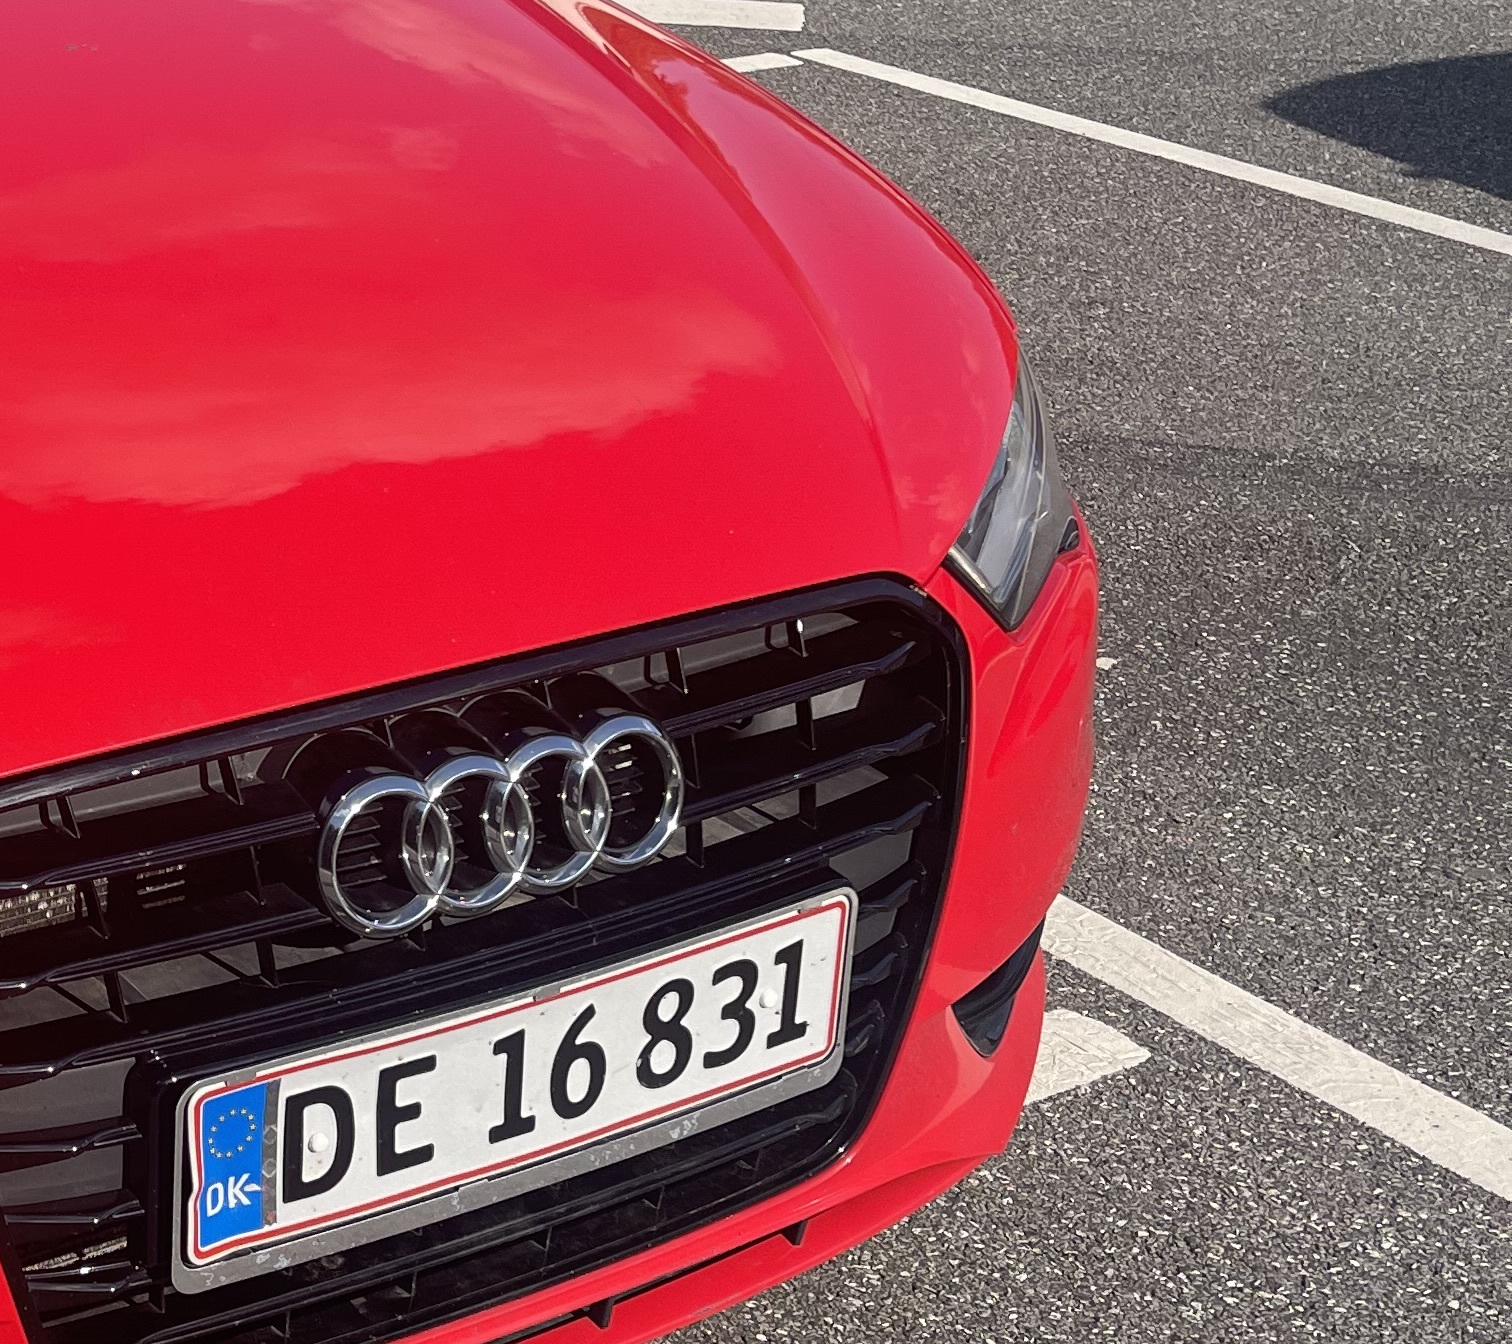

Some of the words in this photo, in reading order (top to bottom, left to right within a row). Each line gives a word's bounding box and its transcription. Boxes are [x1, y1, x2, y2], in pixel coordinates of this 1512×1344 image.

[282, 1054, 438, 1205] DE
[488, 1002, 608, 1145] 16
[635, 938, 810, 1090] 831
[205, 1172, 252, 1217] DK
